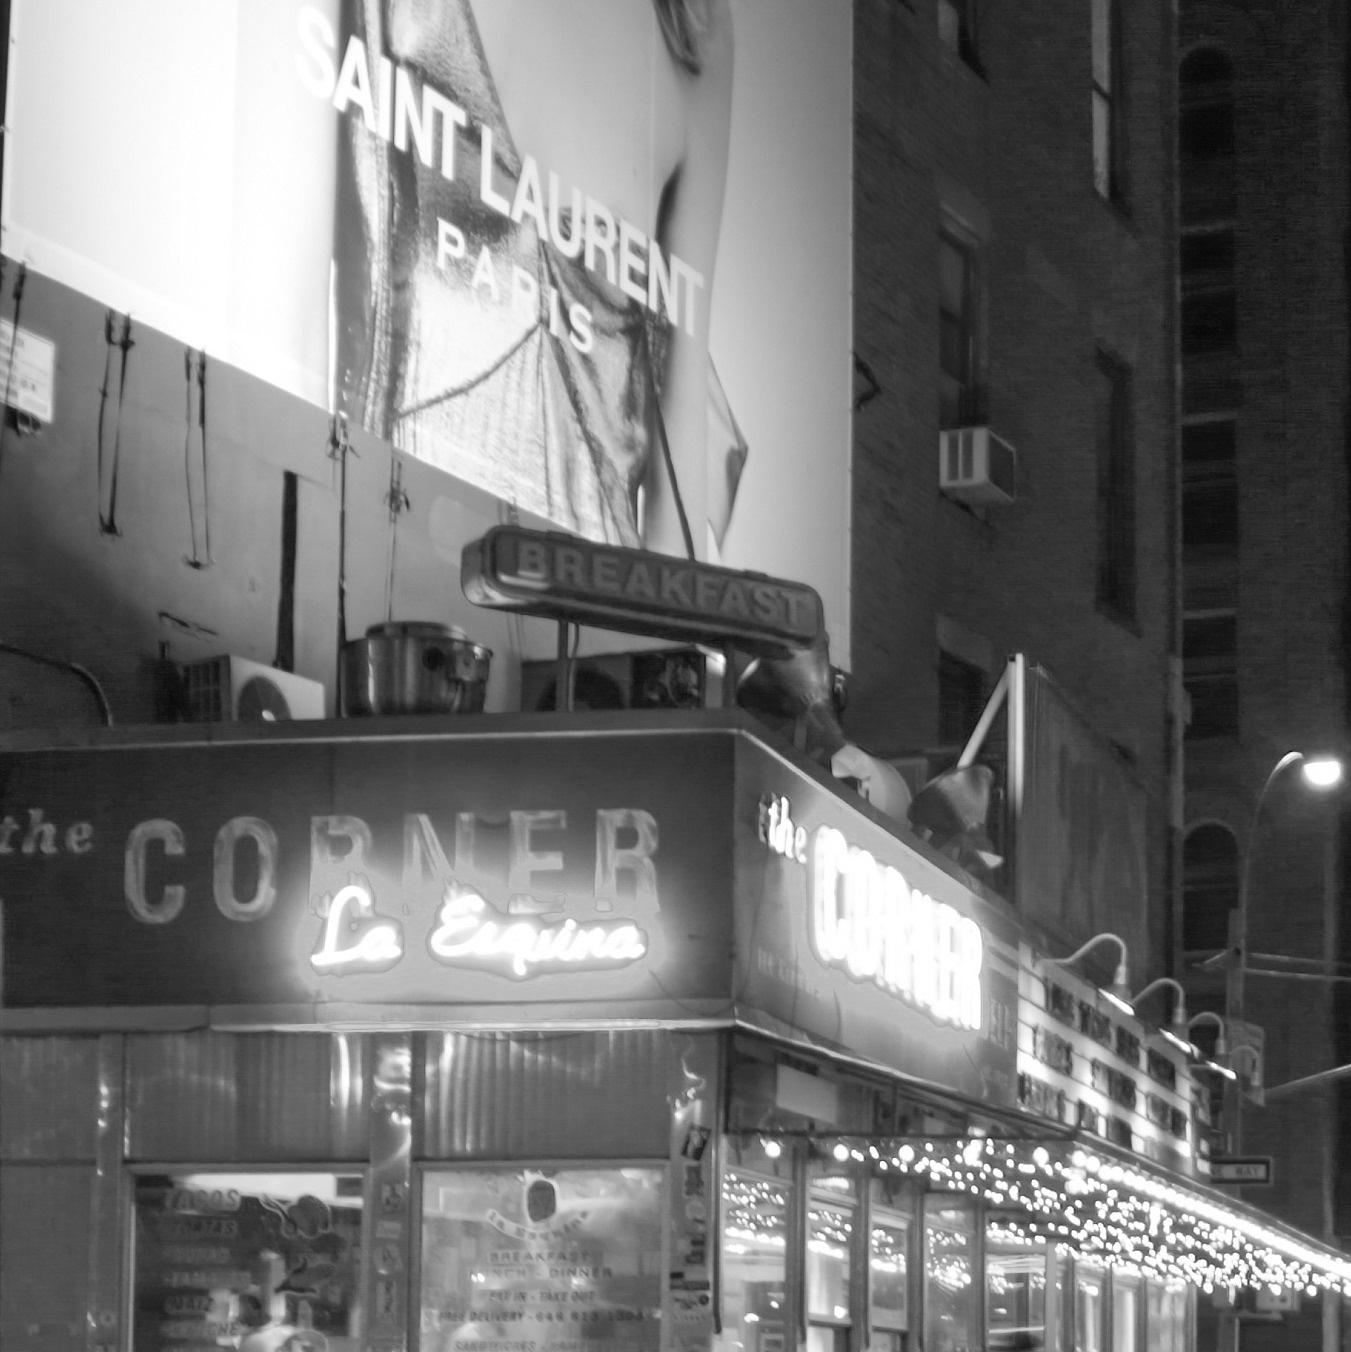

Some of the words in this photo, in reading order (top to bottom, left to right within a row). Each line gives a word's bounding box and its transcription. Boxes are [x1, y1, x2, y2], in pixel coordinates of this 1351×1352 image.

[295, 6, 465, 180] SAINT
[481, 125, 704, 336] LAURENT
[437, 217, 594, 356] PARIS
[516, 540, 812, 631] BREAKFAST
[123, 806, 661, 926] CORNER
[757, 793, 808, 866] the
[310, 884, 404, 968] La
[428, 893, 647, 976] Esquina
[489, 1251, 590, 1263] BREAKFAST
[549, 1267, 612, 1279] DINNER
